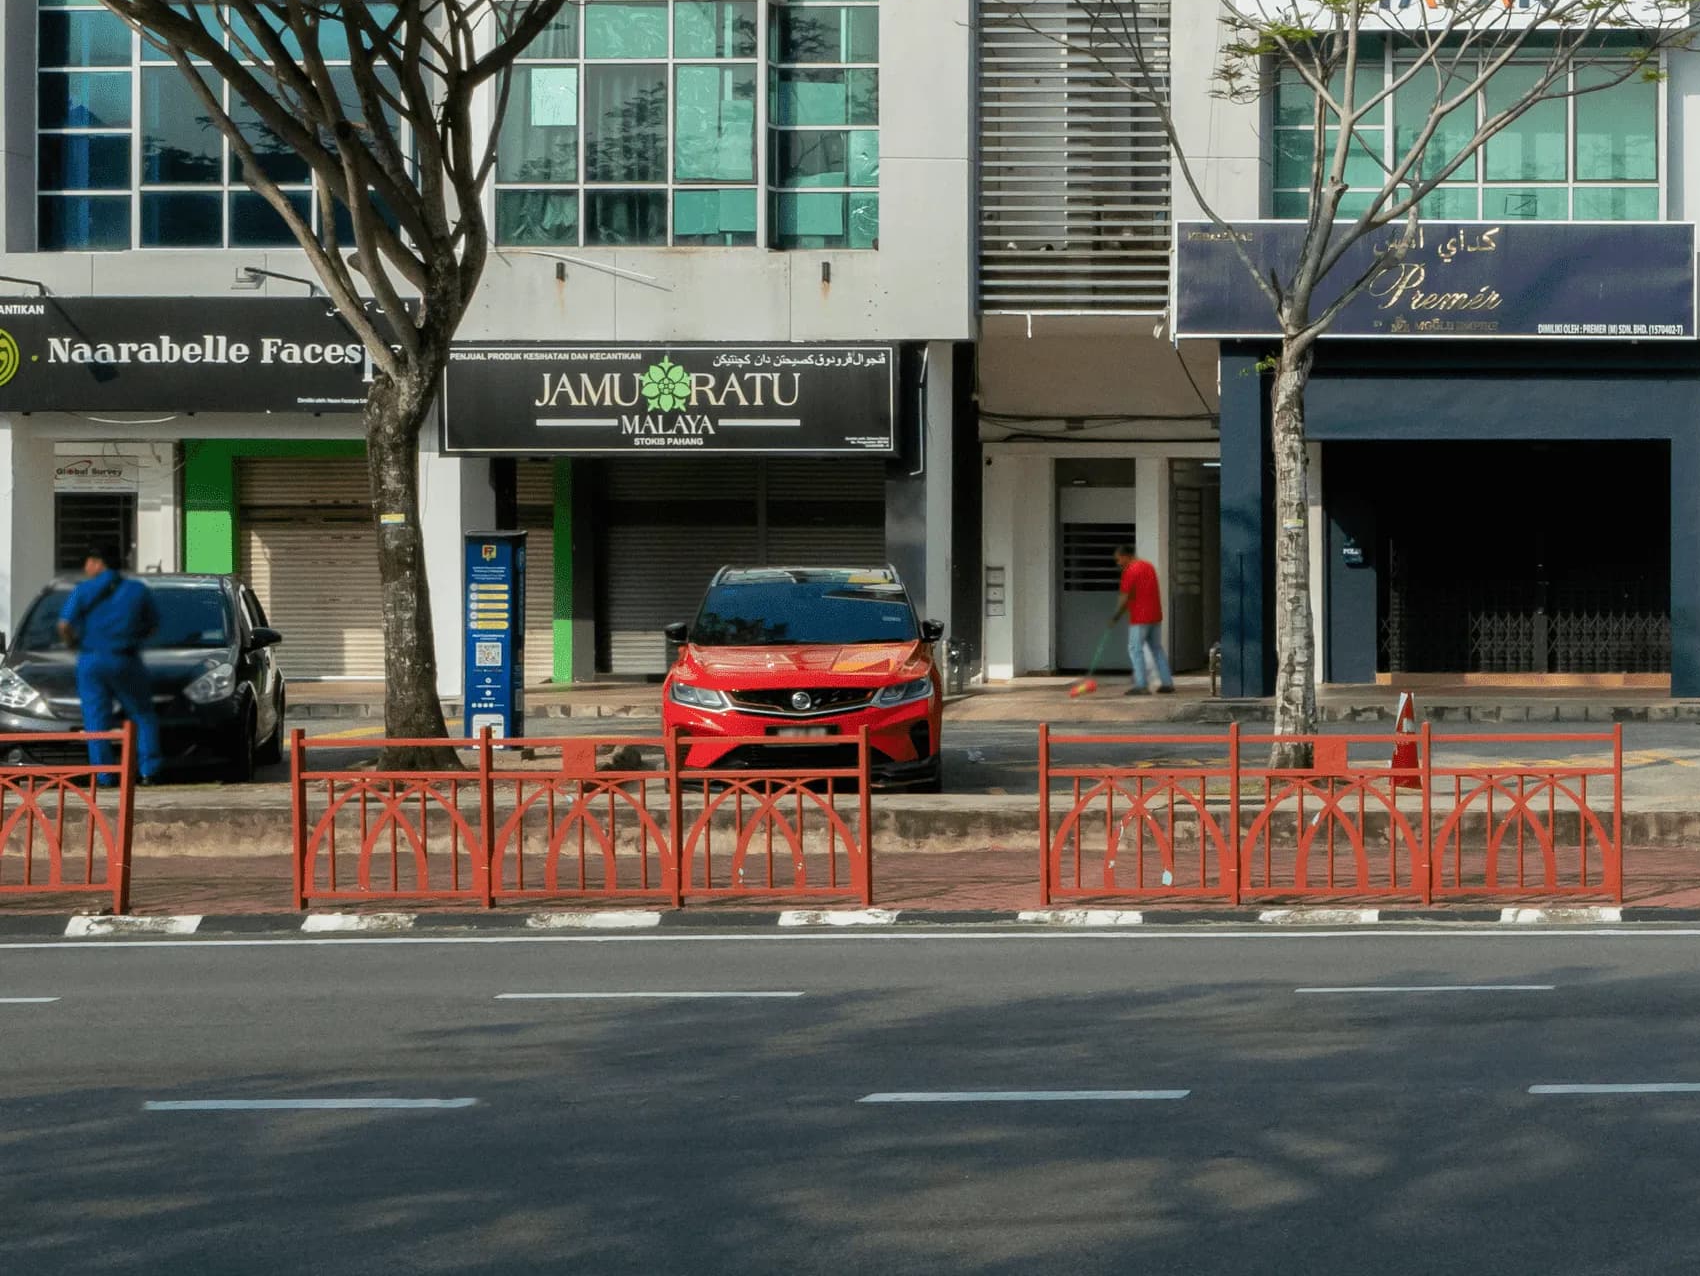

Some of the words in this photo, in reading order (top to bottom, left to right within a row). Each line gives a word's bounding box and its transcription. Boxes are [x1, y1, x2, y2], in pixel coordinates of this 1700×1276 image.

[1563, 324, 1579, 334] OLEH
[1583, 324, 1607, 334] PREMER
[47, 335, 250, 364] Naarabelle
[450, 353, 487, 361] PENJUAL
[535, 372, 641, 406] JAMU
[689, 372, 801, 406] RATU
[621, 414, 716, 435] MALAYA
[56, 467, 89, 475] Global
[91, 467, 122, 477] Survey
